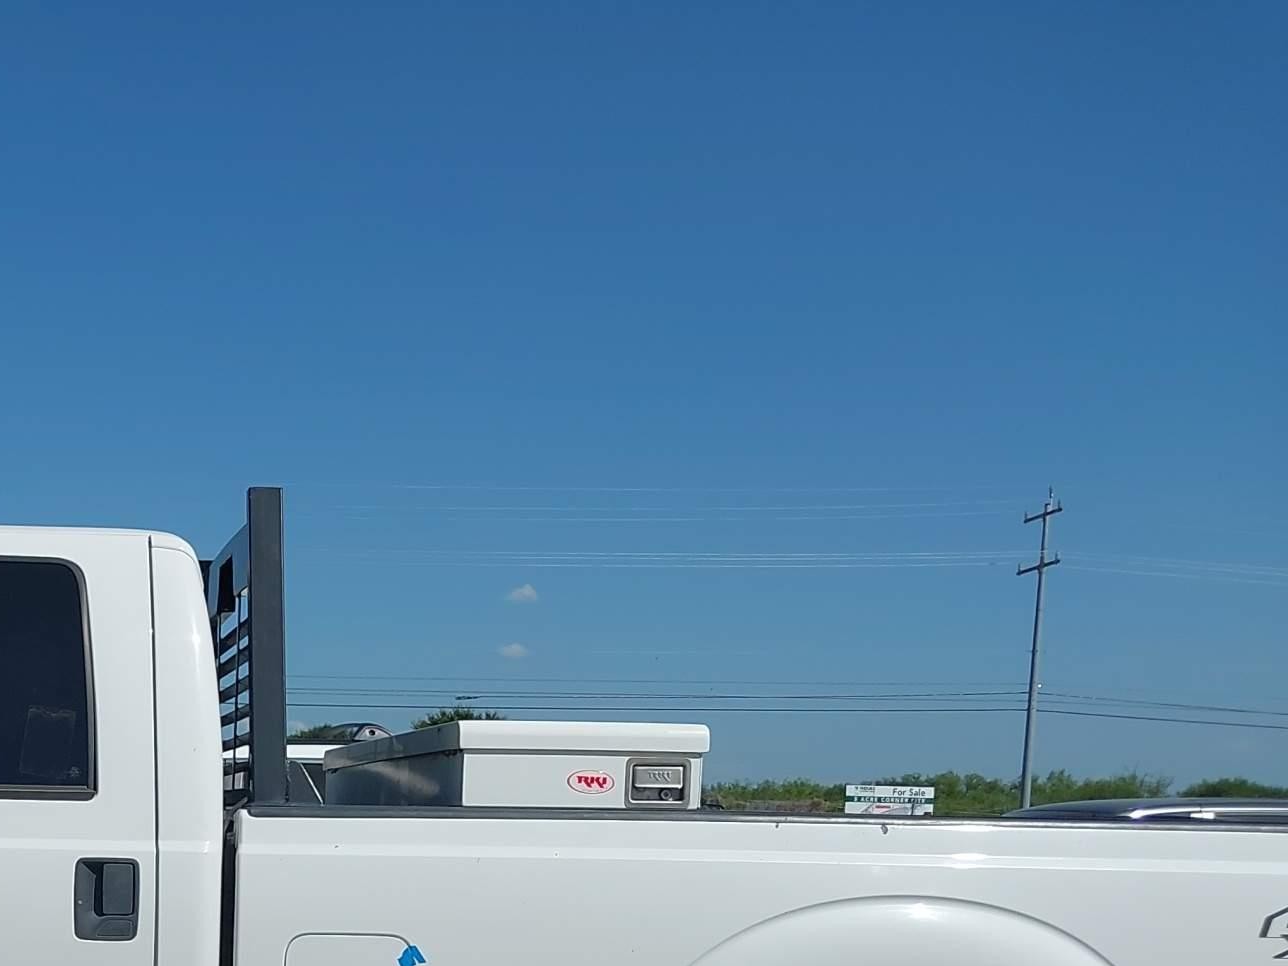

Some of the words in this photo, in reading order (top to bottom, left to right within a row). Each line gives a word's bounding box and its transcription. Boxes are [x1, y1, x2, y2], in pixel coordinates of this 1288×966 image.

[576, 775, 608, 789] RKI
[892, 787, 907, 796] For
[909, 788, 926, 797] Sale
